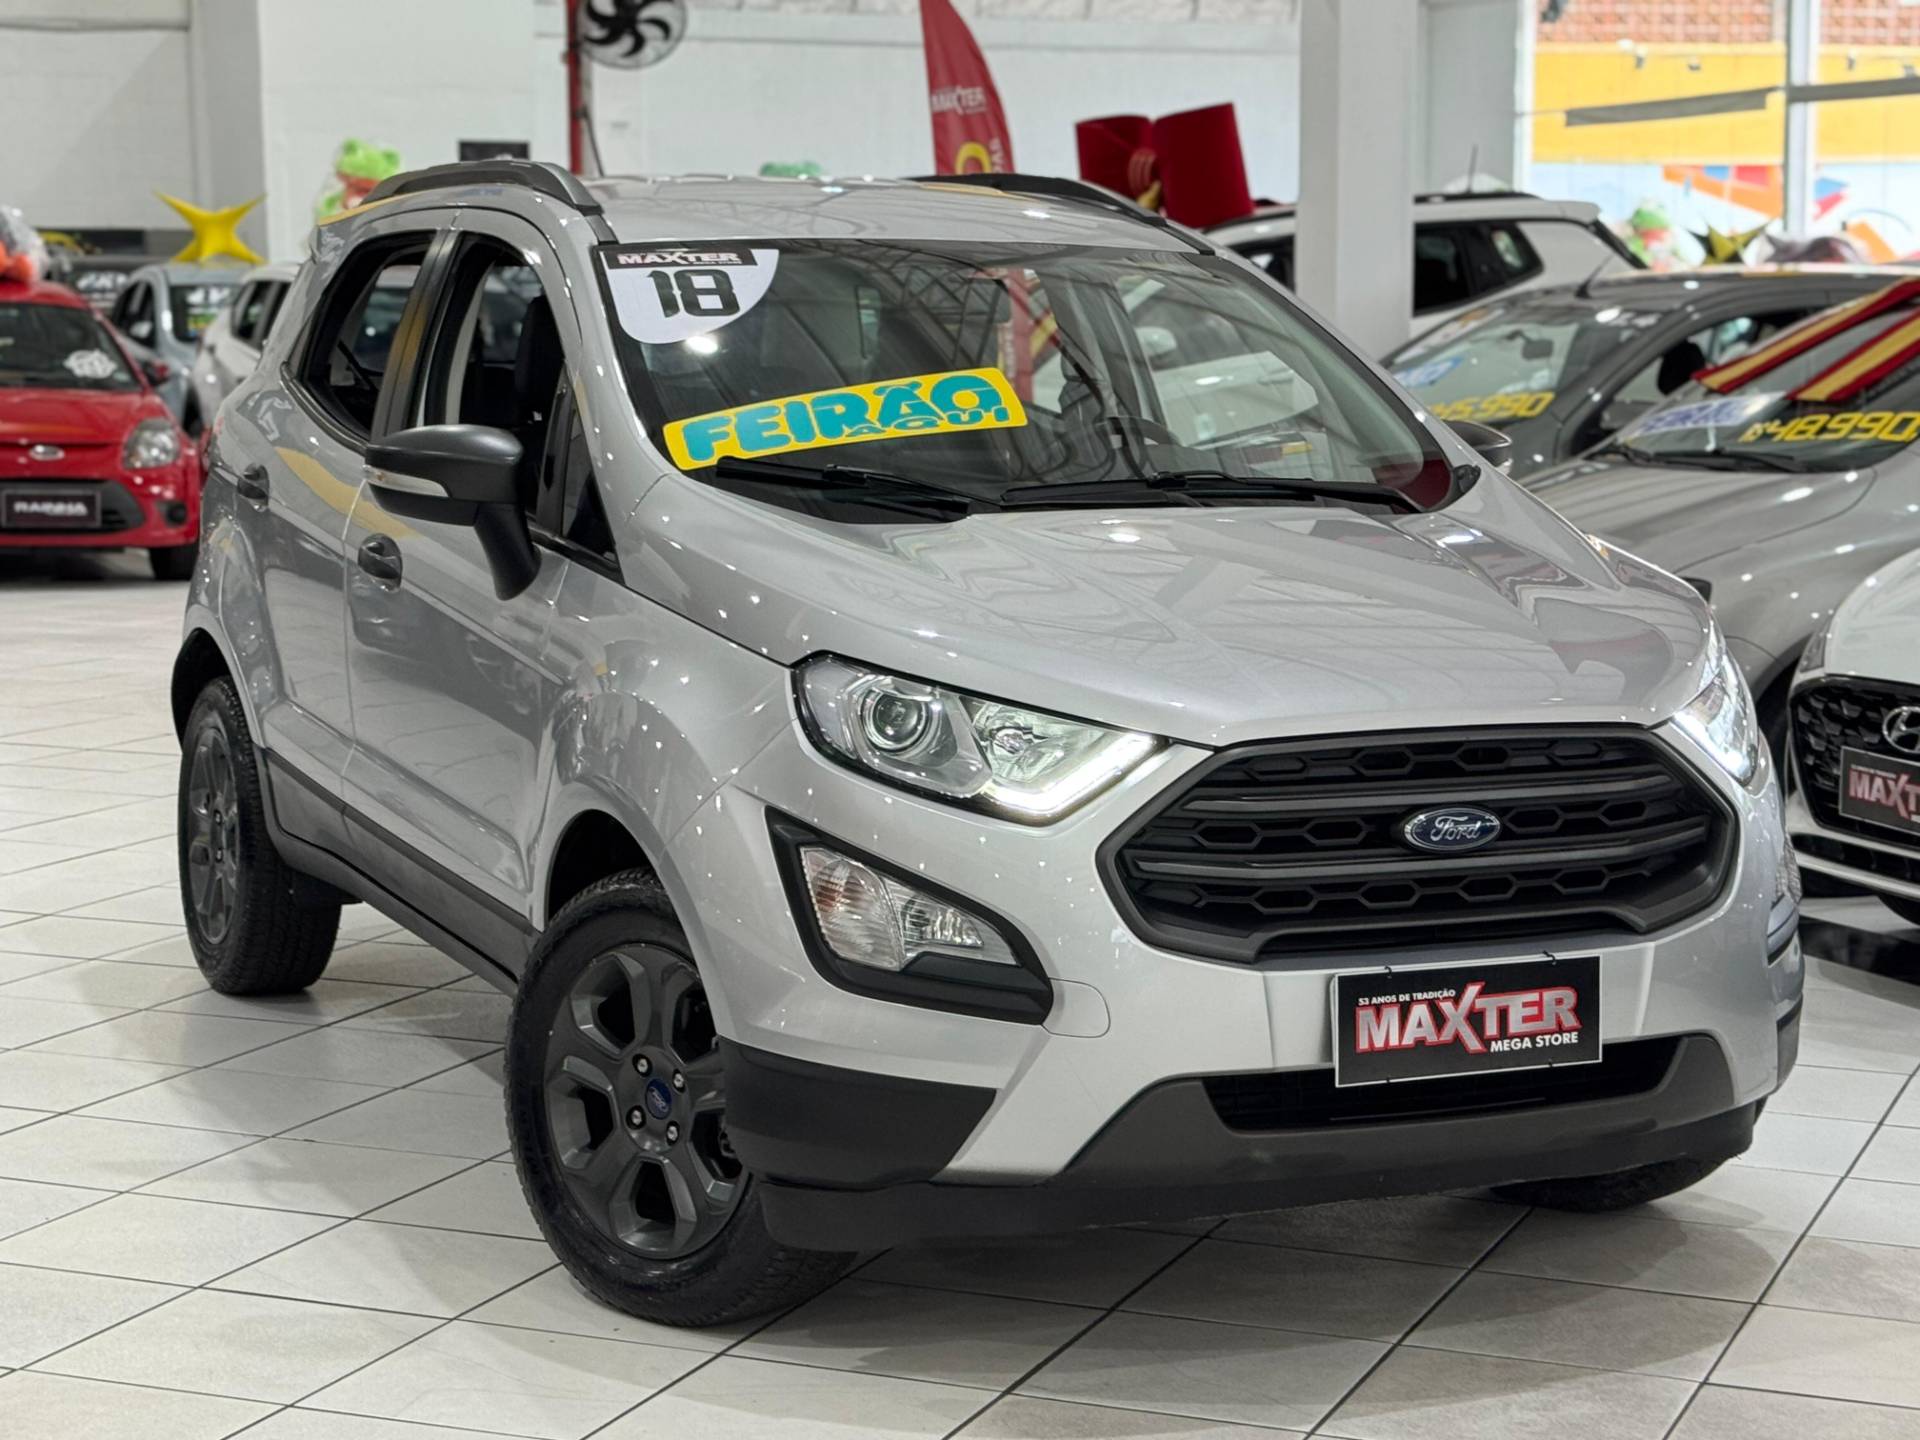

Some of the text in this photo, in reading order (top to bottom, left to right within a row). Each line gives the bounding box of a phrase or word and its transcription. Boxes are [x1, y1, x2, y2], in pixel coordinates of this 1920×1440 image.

[617, 252, 741, 265] MAXTER
[646, 269, 740, 318] 18
[681, 374, 1003, 461] FEIRÃO
[1430, 815, 1482, 842] Ford
[1358, 988, 1457, 1006] 53 ANOS DE TRADIÇÃO
[1355, 981, 1583, 1054] MAXTER
[1490, 1032, 1579, 1053] MEGA STORE
